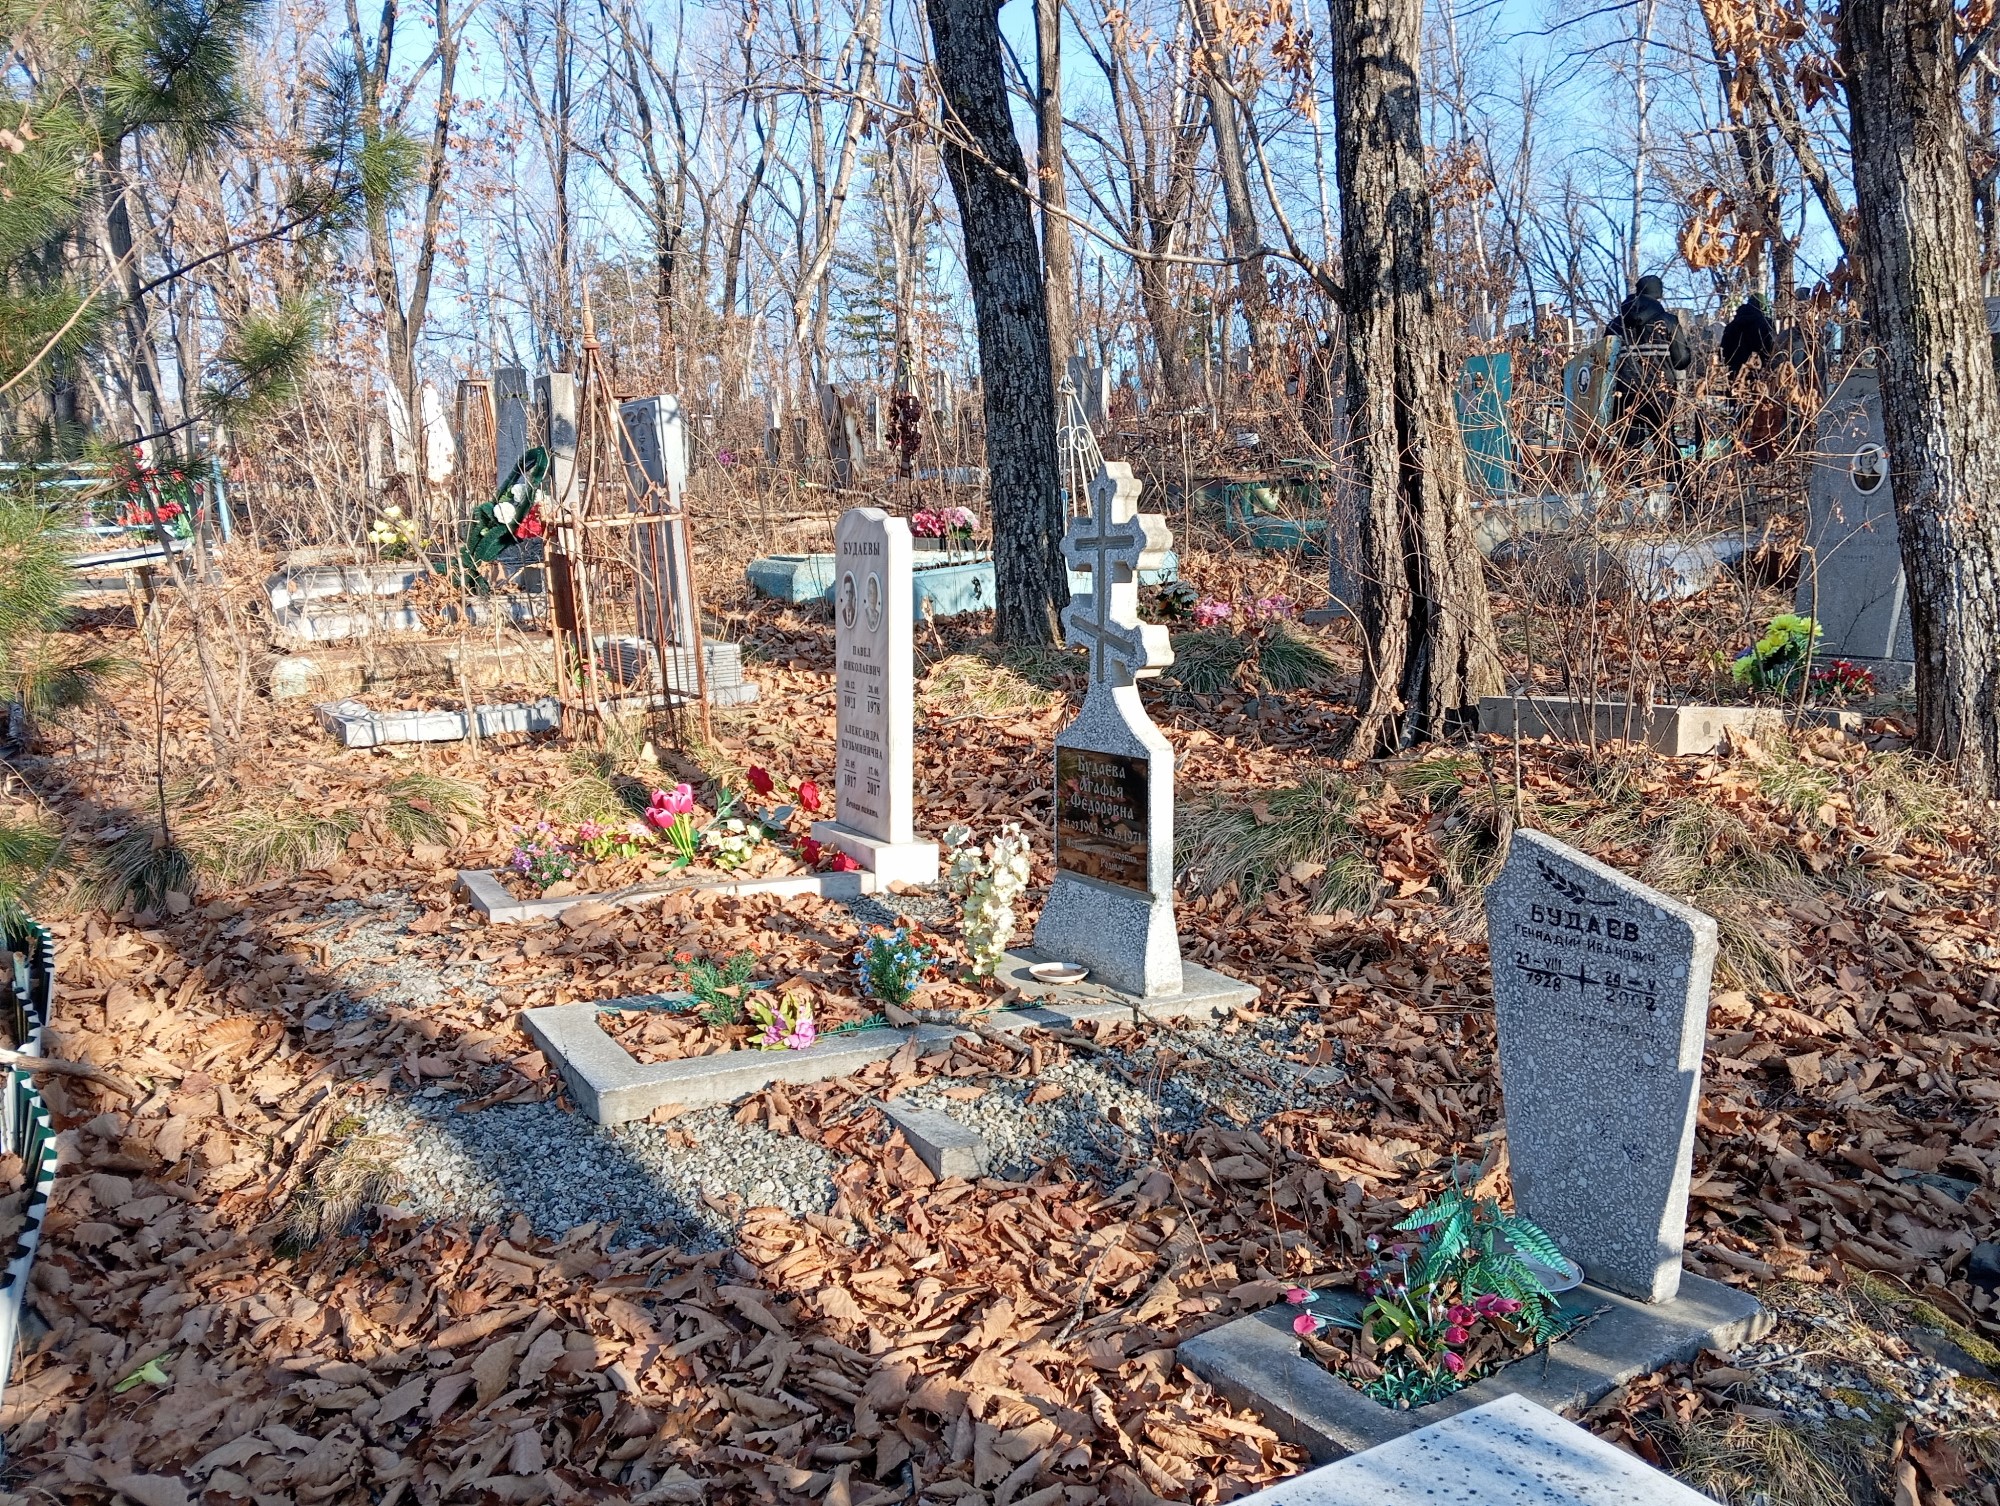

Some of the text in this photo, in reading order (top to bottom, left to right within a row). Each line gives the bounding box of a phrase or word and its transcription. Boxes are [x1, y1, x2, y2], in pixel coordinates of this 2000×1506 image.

[843, 542, 880, 556] БУДАЕВЫ
[852, 645, 871, 658] ПАВЕЛ
[843, 660, 881, 677] НИКОЛАЕВИЧ
[867, 700, 880, 715] 1978
[844, 724, 880, 742] АЛЕКСАНДРА
[841, 738, 883, 760] КУЗЬМИНИЧНА
[1077, 755, 1126, 779] Будаева
[844, 773, 856, 788] 1917
[867, 781, 880, 797] 2007
[1079, 776, 1124, 800] Агафья
[1531, 904, 1639, 942] БУДАЕВ
[1514, 924, 1581, 948] ГЕННАДИЙ
[1526, 972, 1562, 992] 1928
[1606, 987, 1657, 1012] 2002
